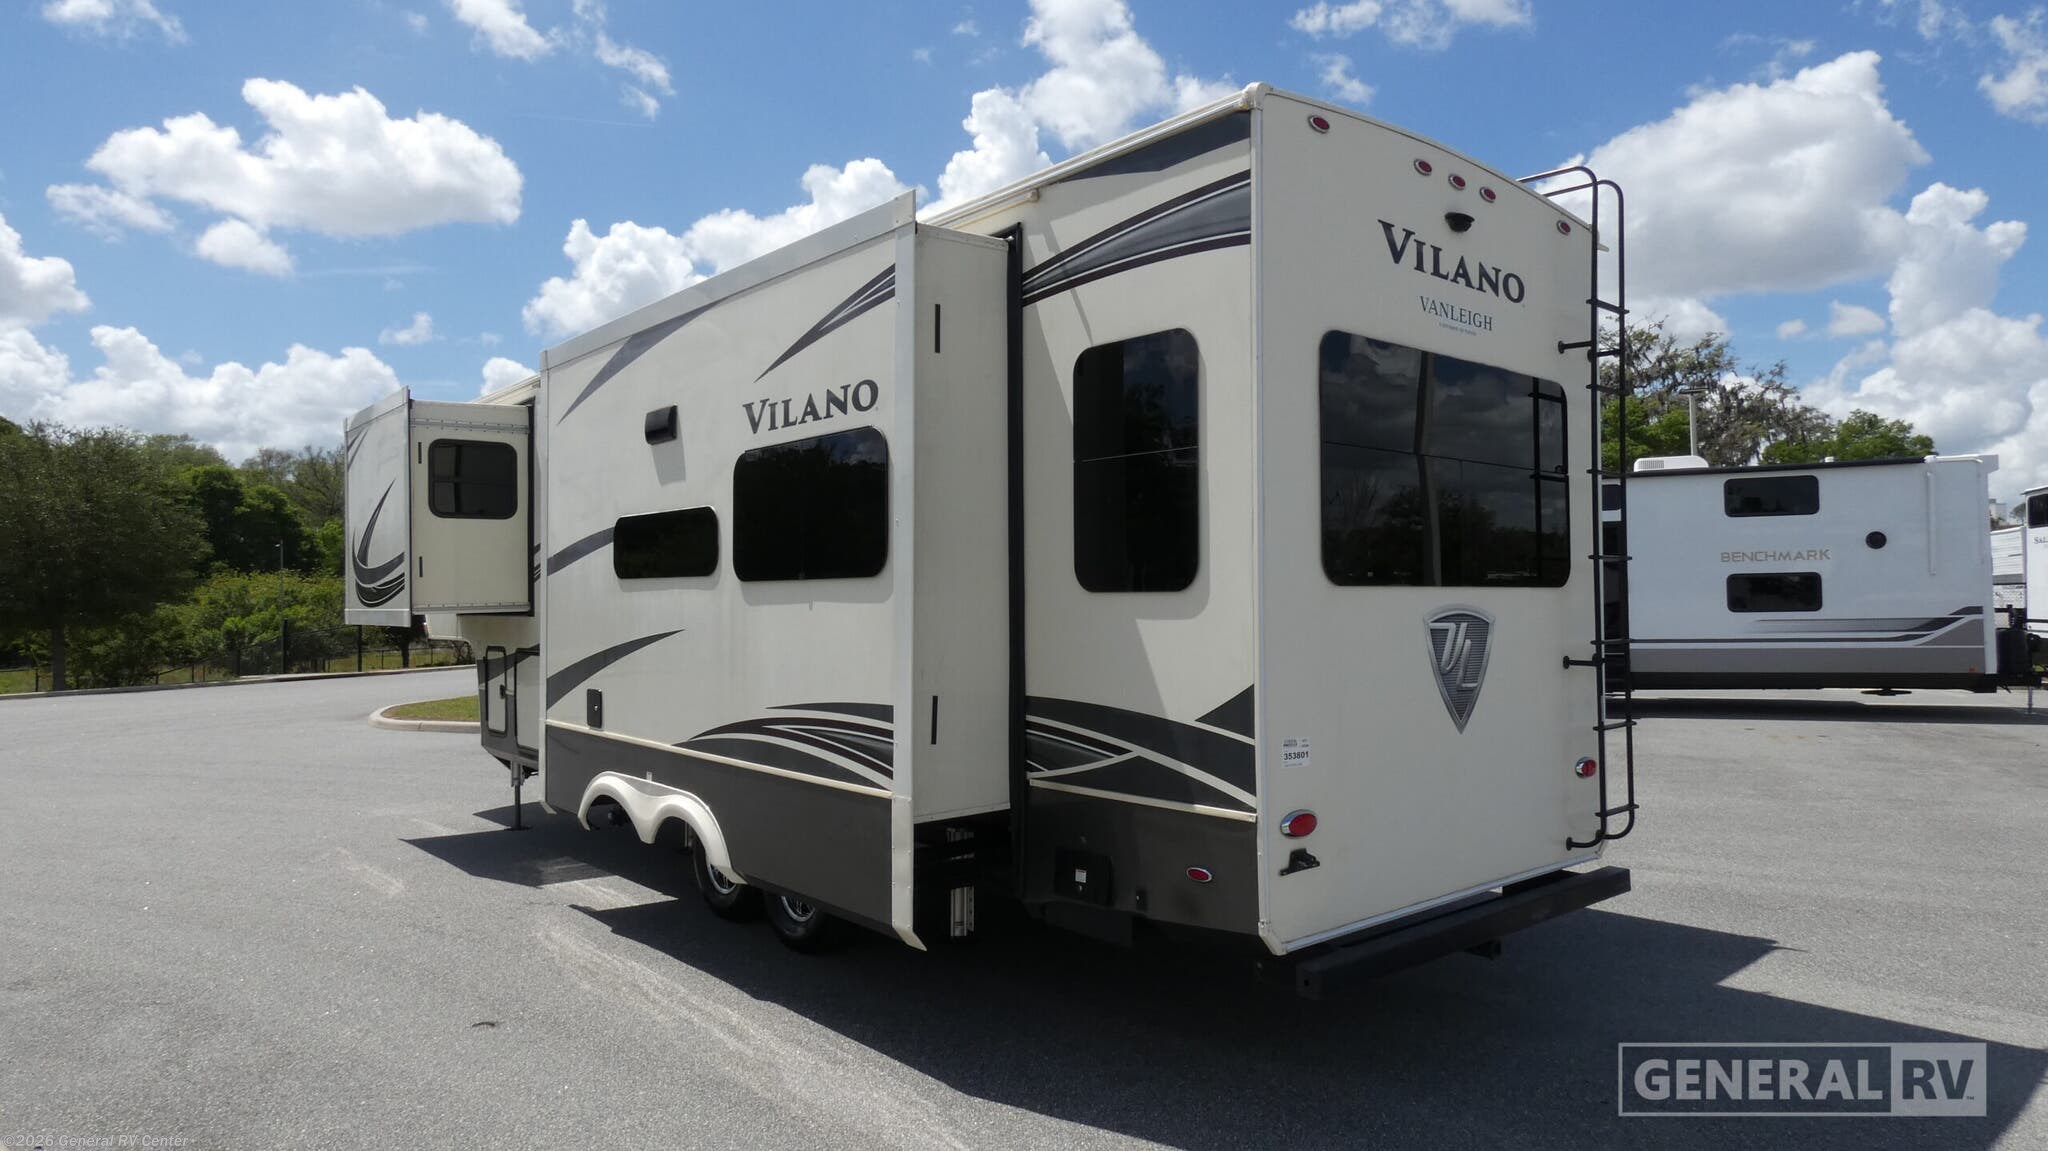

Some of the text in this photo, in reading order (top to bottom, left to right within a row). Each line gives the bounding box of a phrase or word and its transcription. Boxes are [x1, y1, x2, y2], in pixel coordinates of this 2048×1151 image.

[1377, 219, 1525, 304] VILANO
[1420, 295, 1493, 331] VANLEIGH
[742, 379, 879, 434] VILANO
[1720, 549, 1831, 563] BENCHMARK
[1283, 751, 1309, 760] 353801
